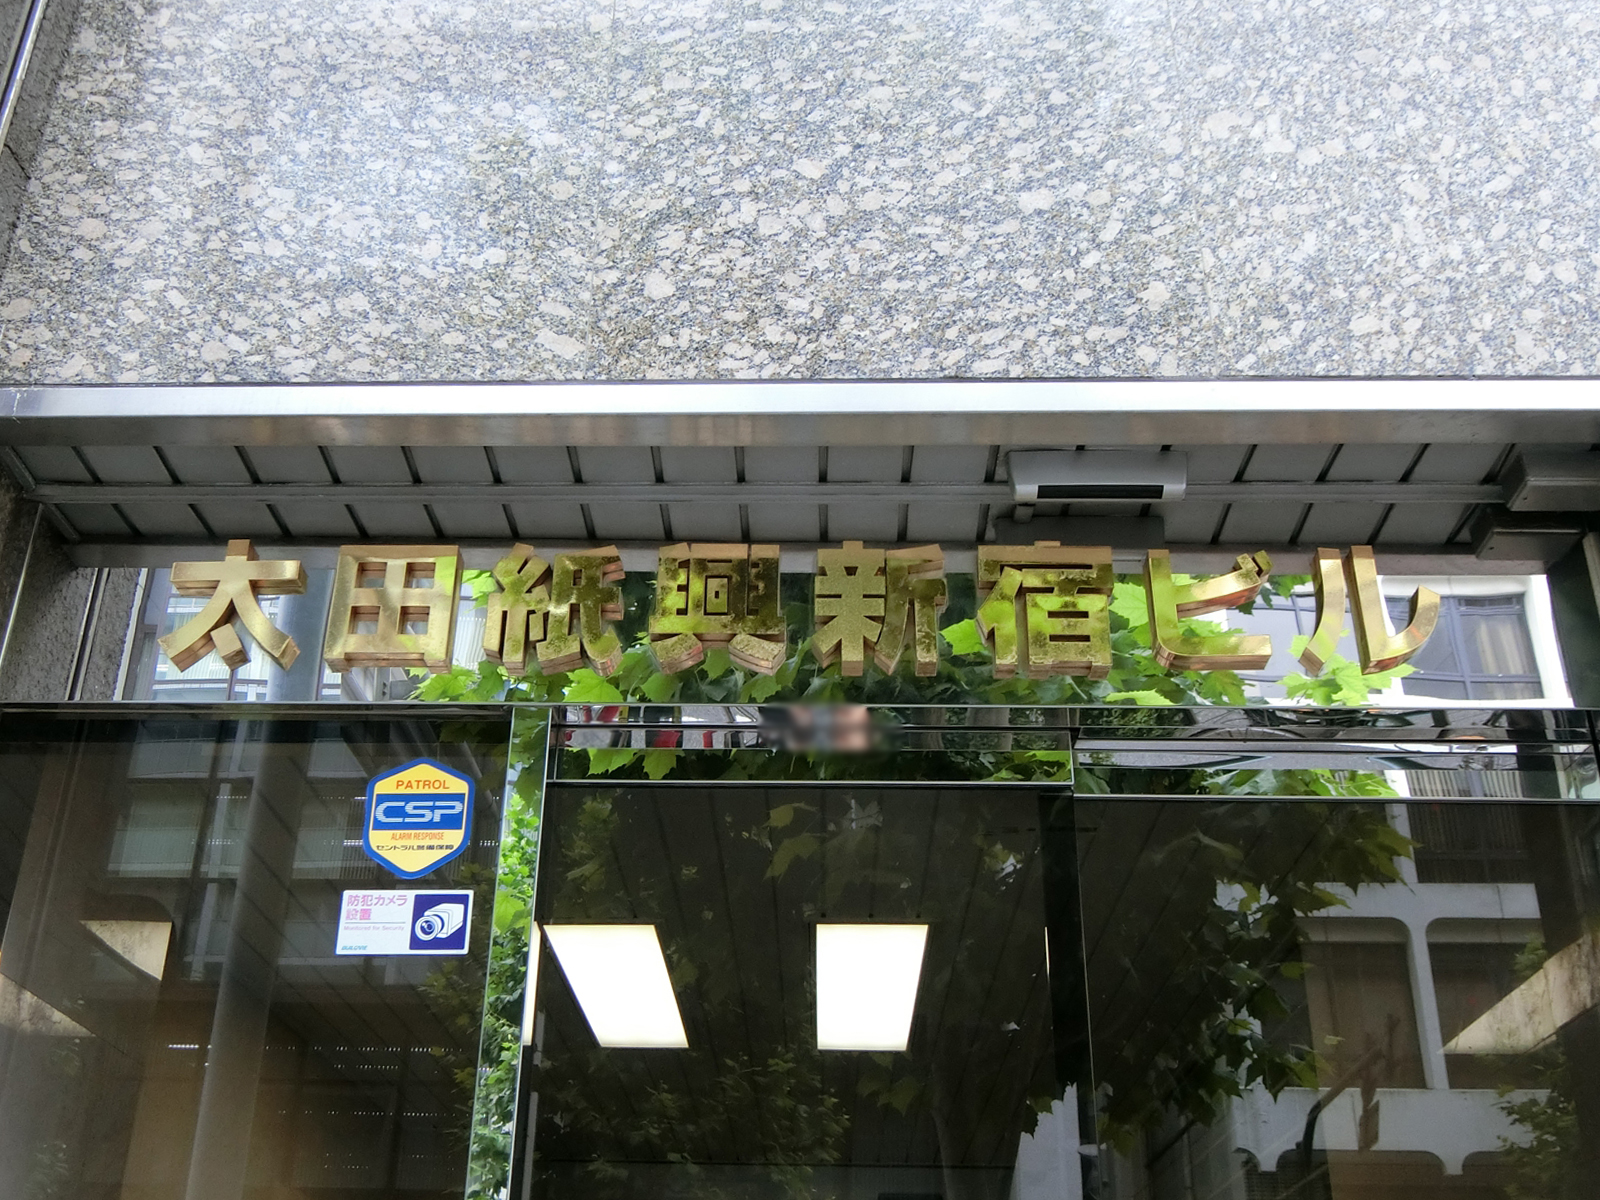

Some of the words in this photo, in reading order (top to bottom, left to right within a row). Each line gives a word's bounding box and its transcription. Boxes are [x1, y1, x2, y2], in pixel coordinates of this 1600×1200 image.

[157, 538, 1441, 678] 太田紙興新宿ビル
[395, 779, 450, 790] PATROL
[375, 801, 464, 823] CSP
[391, 832, 412, 841] ALARM
[413, 832, 445, 841] RESPONSE
[347, 894, 408, 907] 防犯カメラ
[345, 908, 372, 921] 設置
